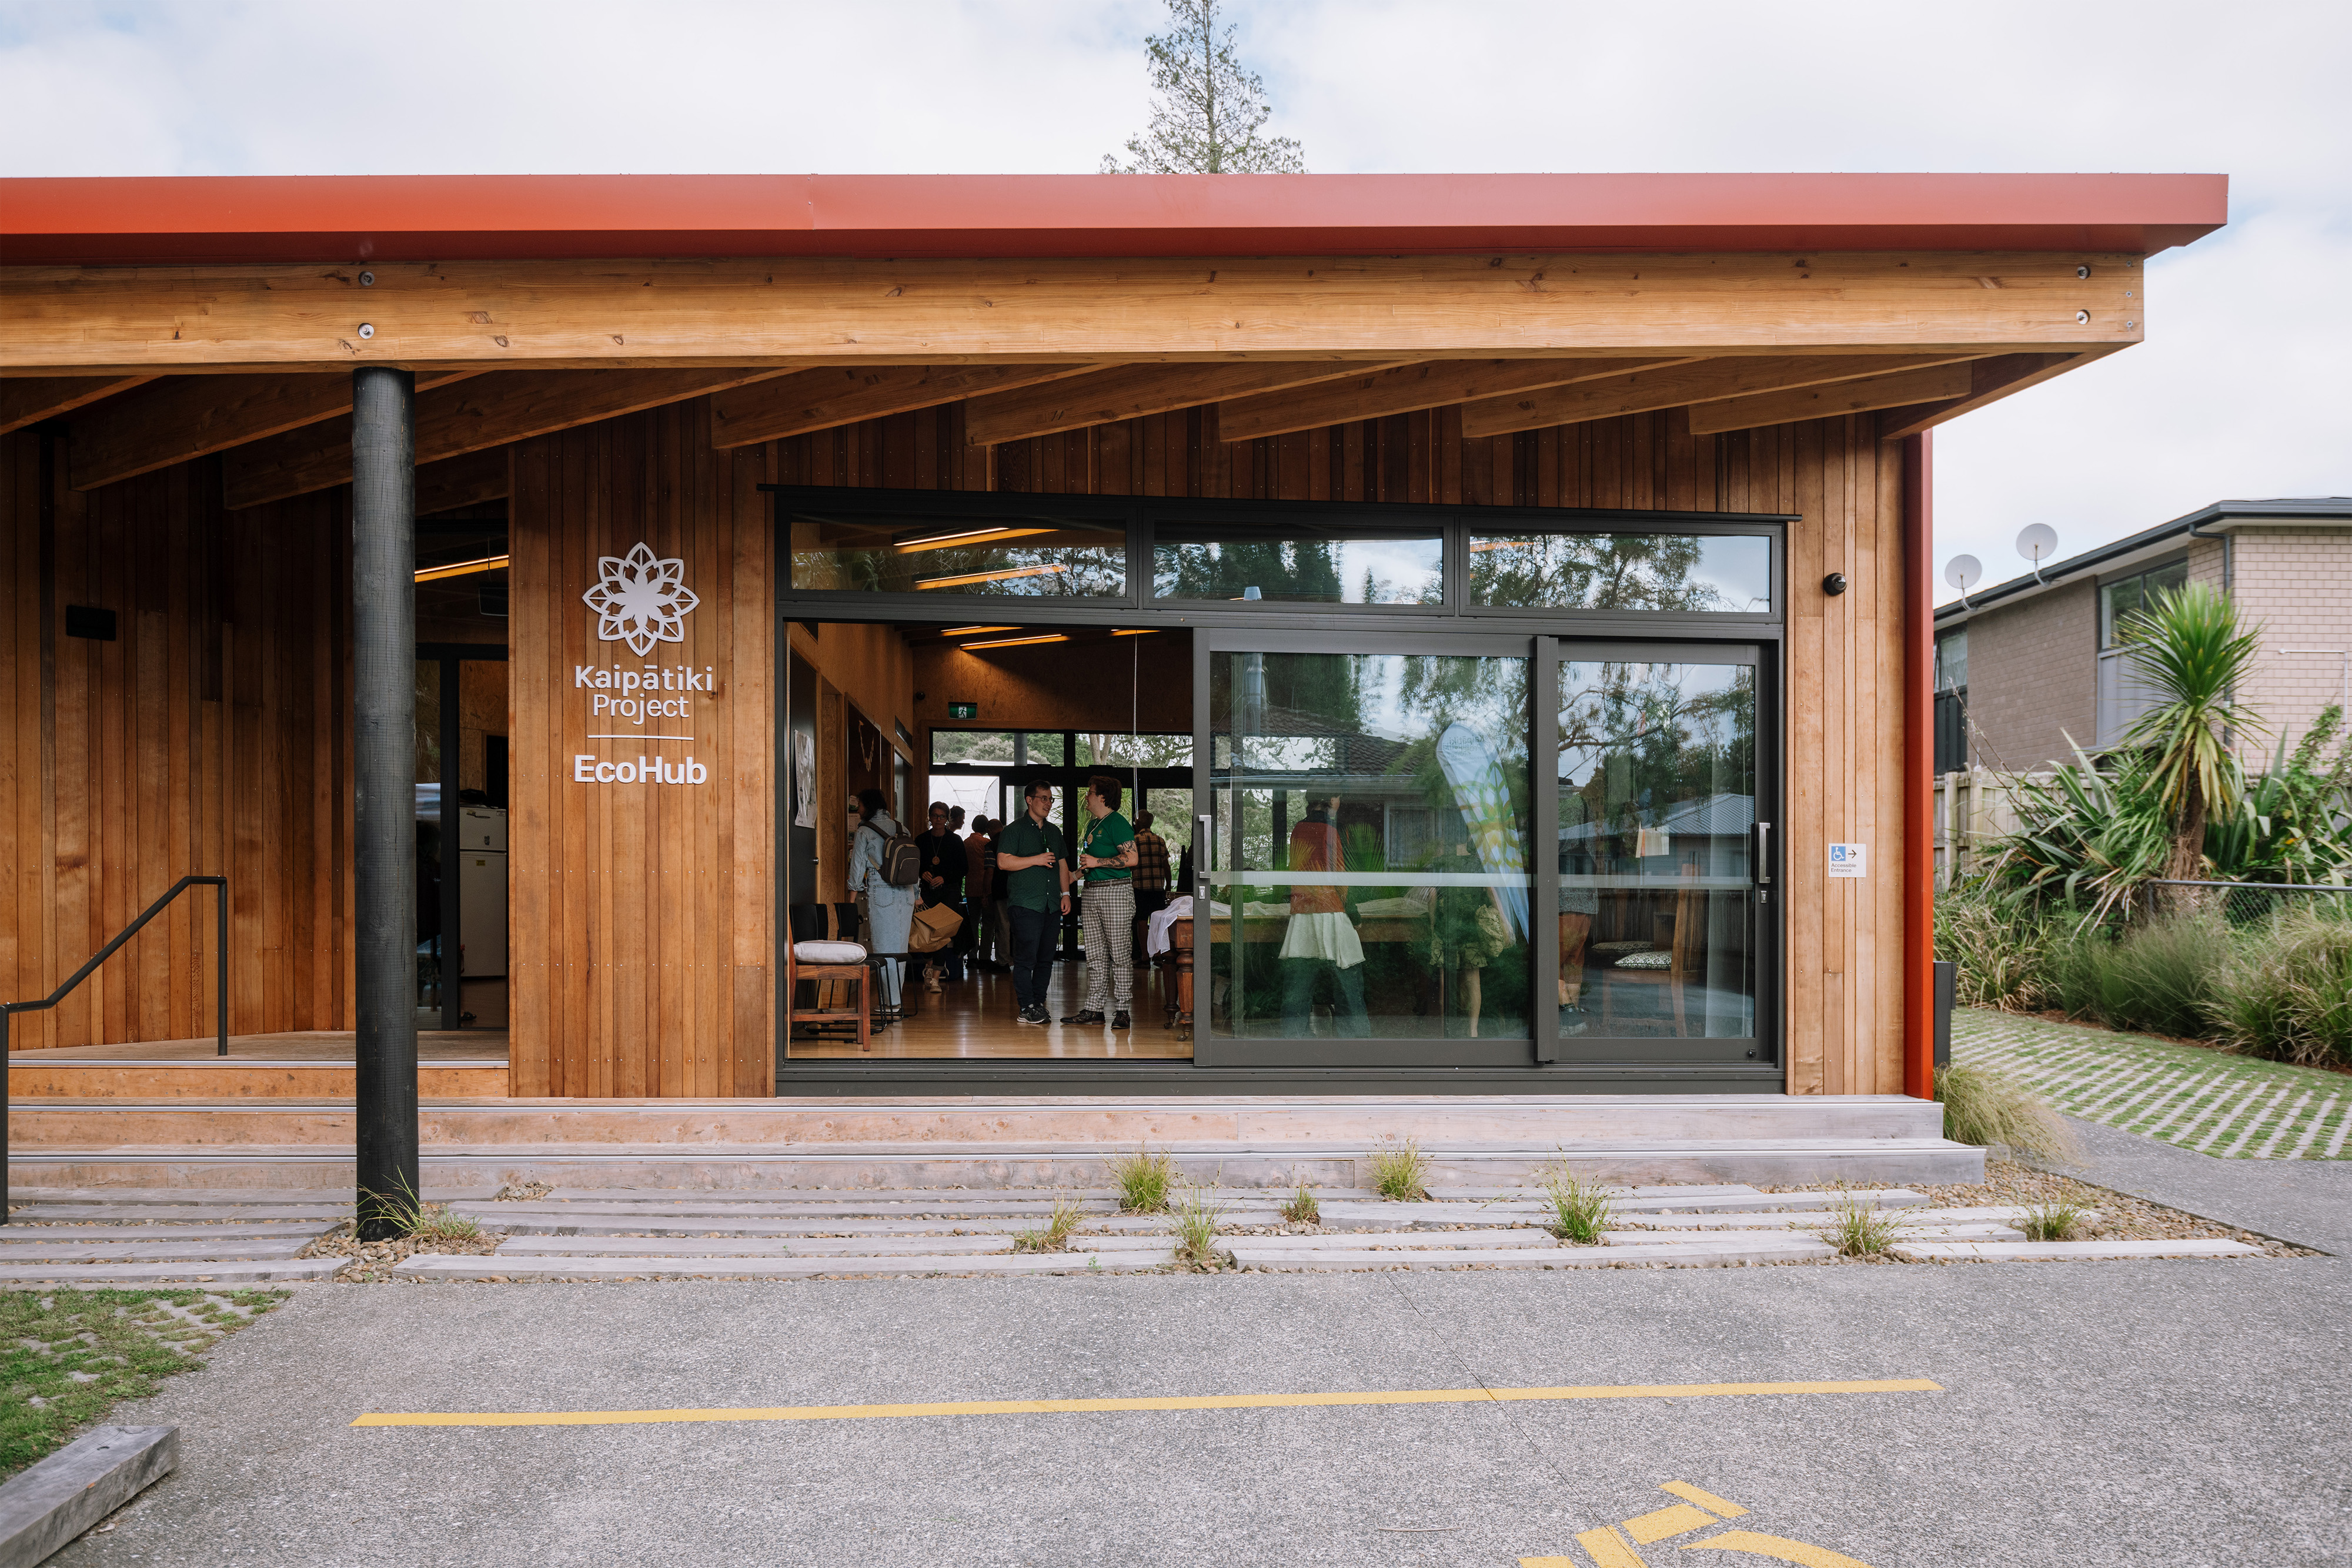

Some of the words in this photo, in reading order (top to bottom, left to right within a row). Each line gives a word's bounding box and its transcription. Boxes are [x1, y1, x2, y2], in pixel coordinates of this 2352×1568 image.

[575, 664, 713, 697] Kaipātiki
[593, 693, 689, 725] Project
[574, 755, 707, 784] EcoHub
